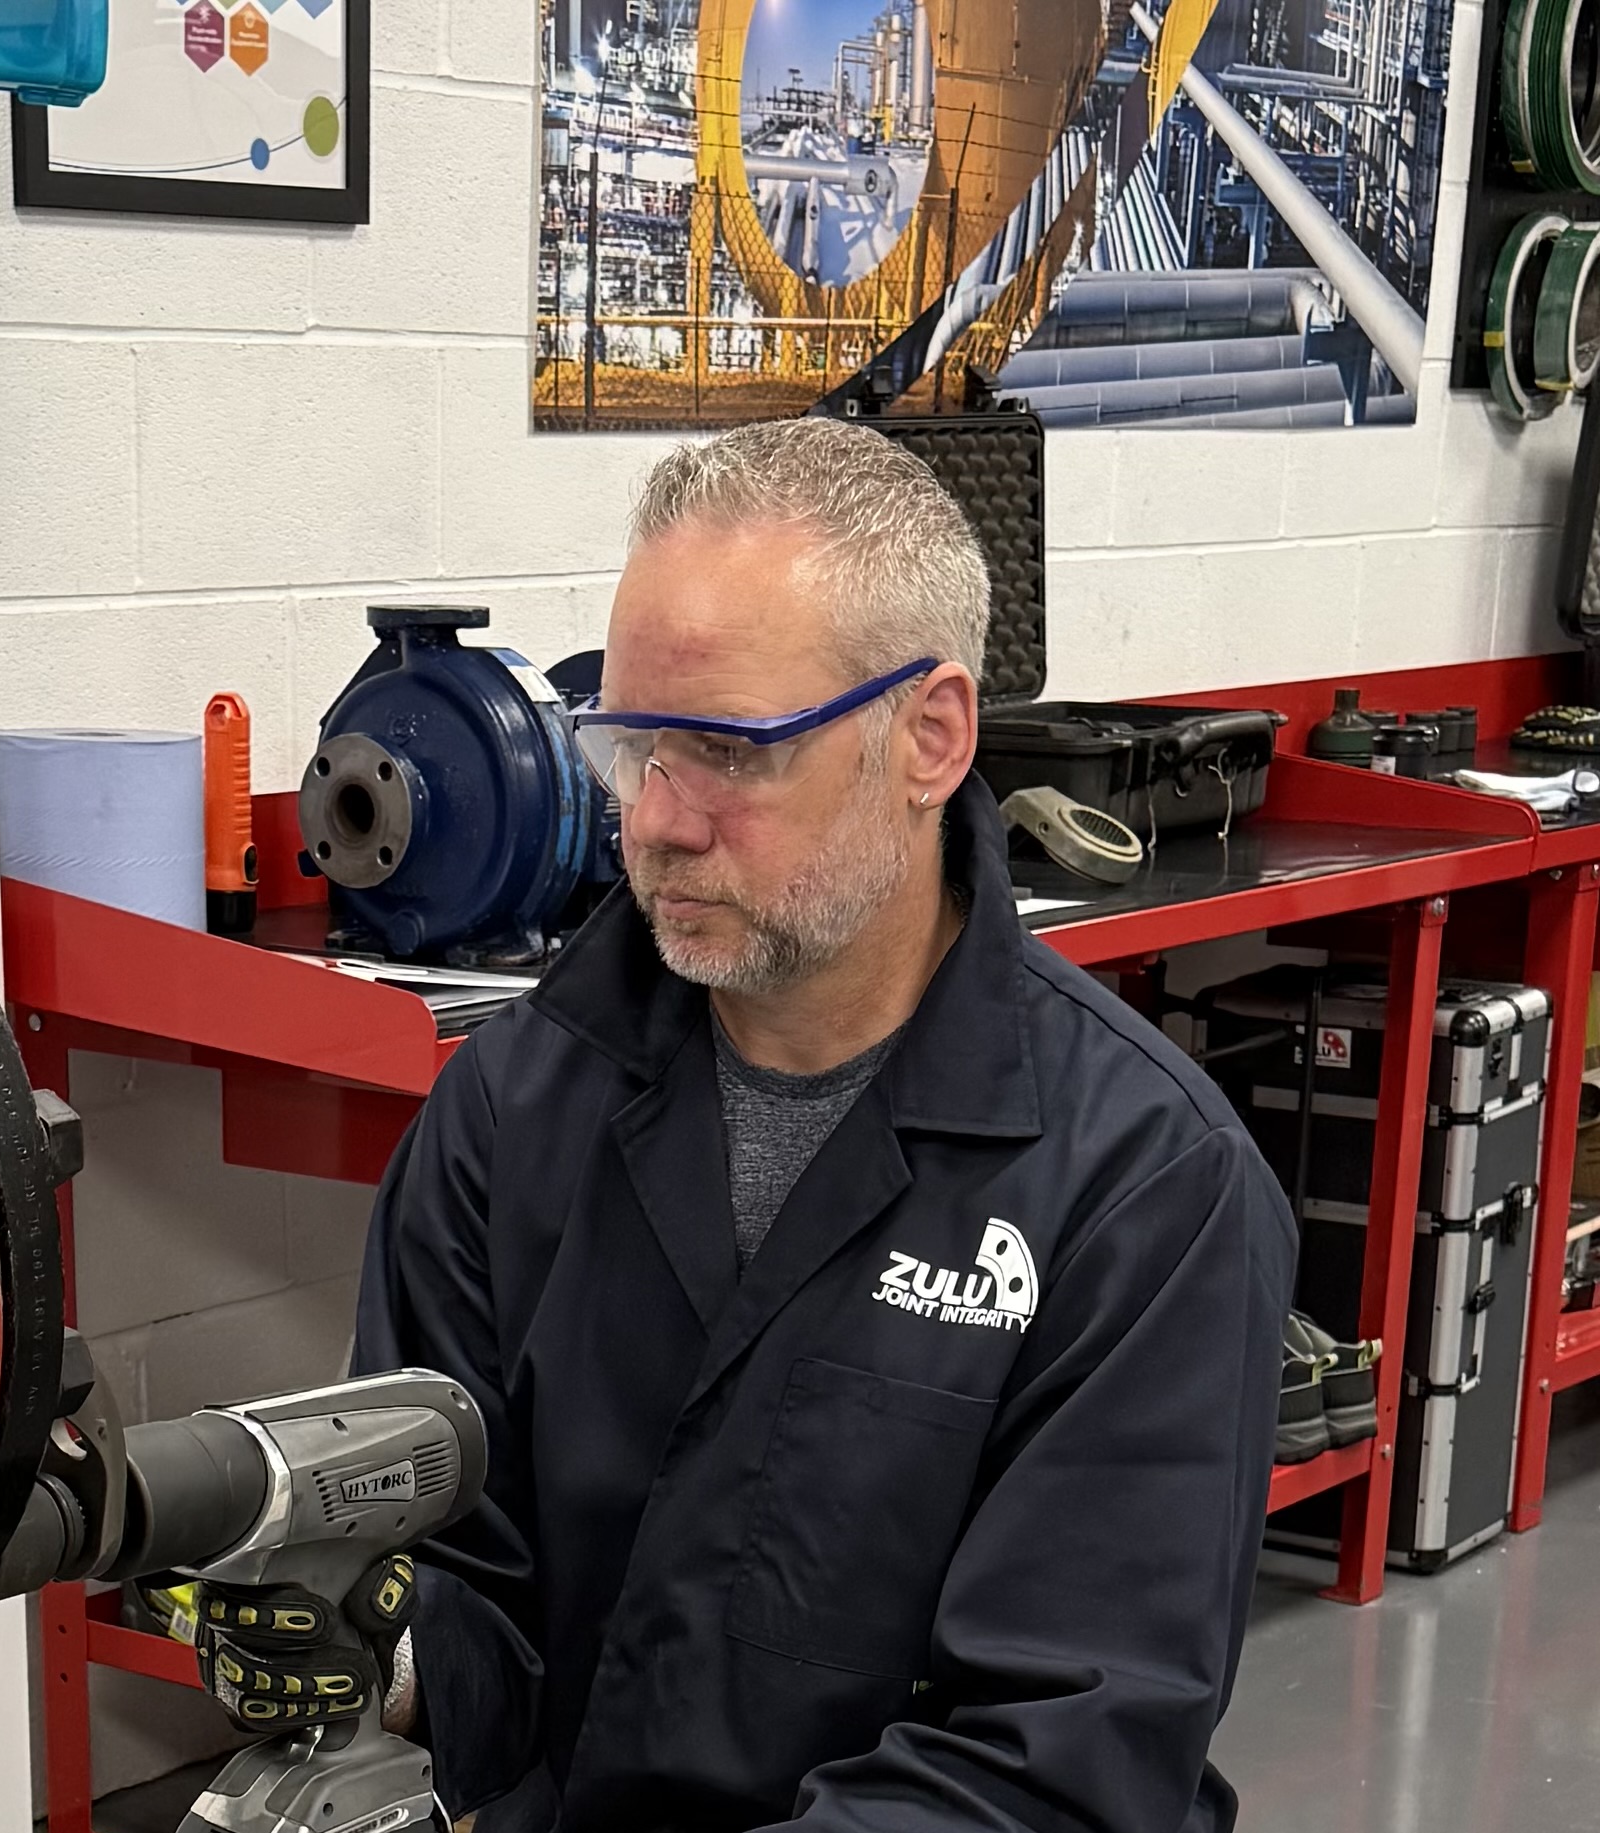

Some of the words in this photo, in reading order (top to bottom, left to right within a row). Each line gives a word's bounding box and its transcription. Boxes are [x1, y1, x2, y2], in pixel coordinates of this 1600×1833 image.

[879, 1251, 993, 1307] ZULU
[872, 1284, 939, 1318] JOINT
[939, 1304, 1032, 1334] INTEGRITY
[347, 1470, 413, 1499] HYTORC
